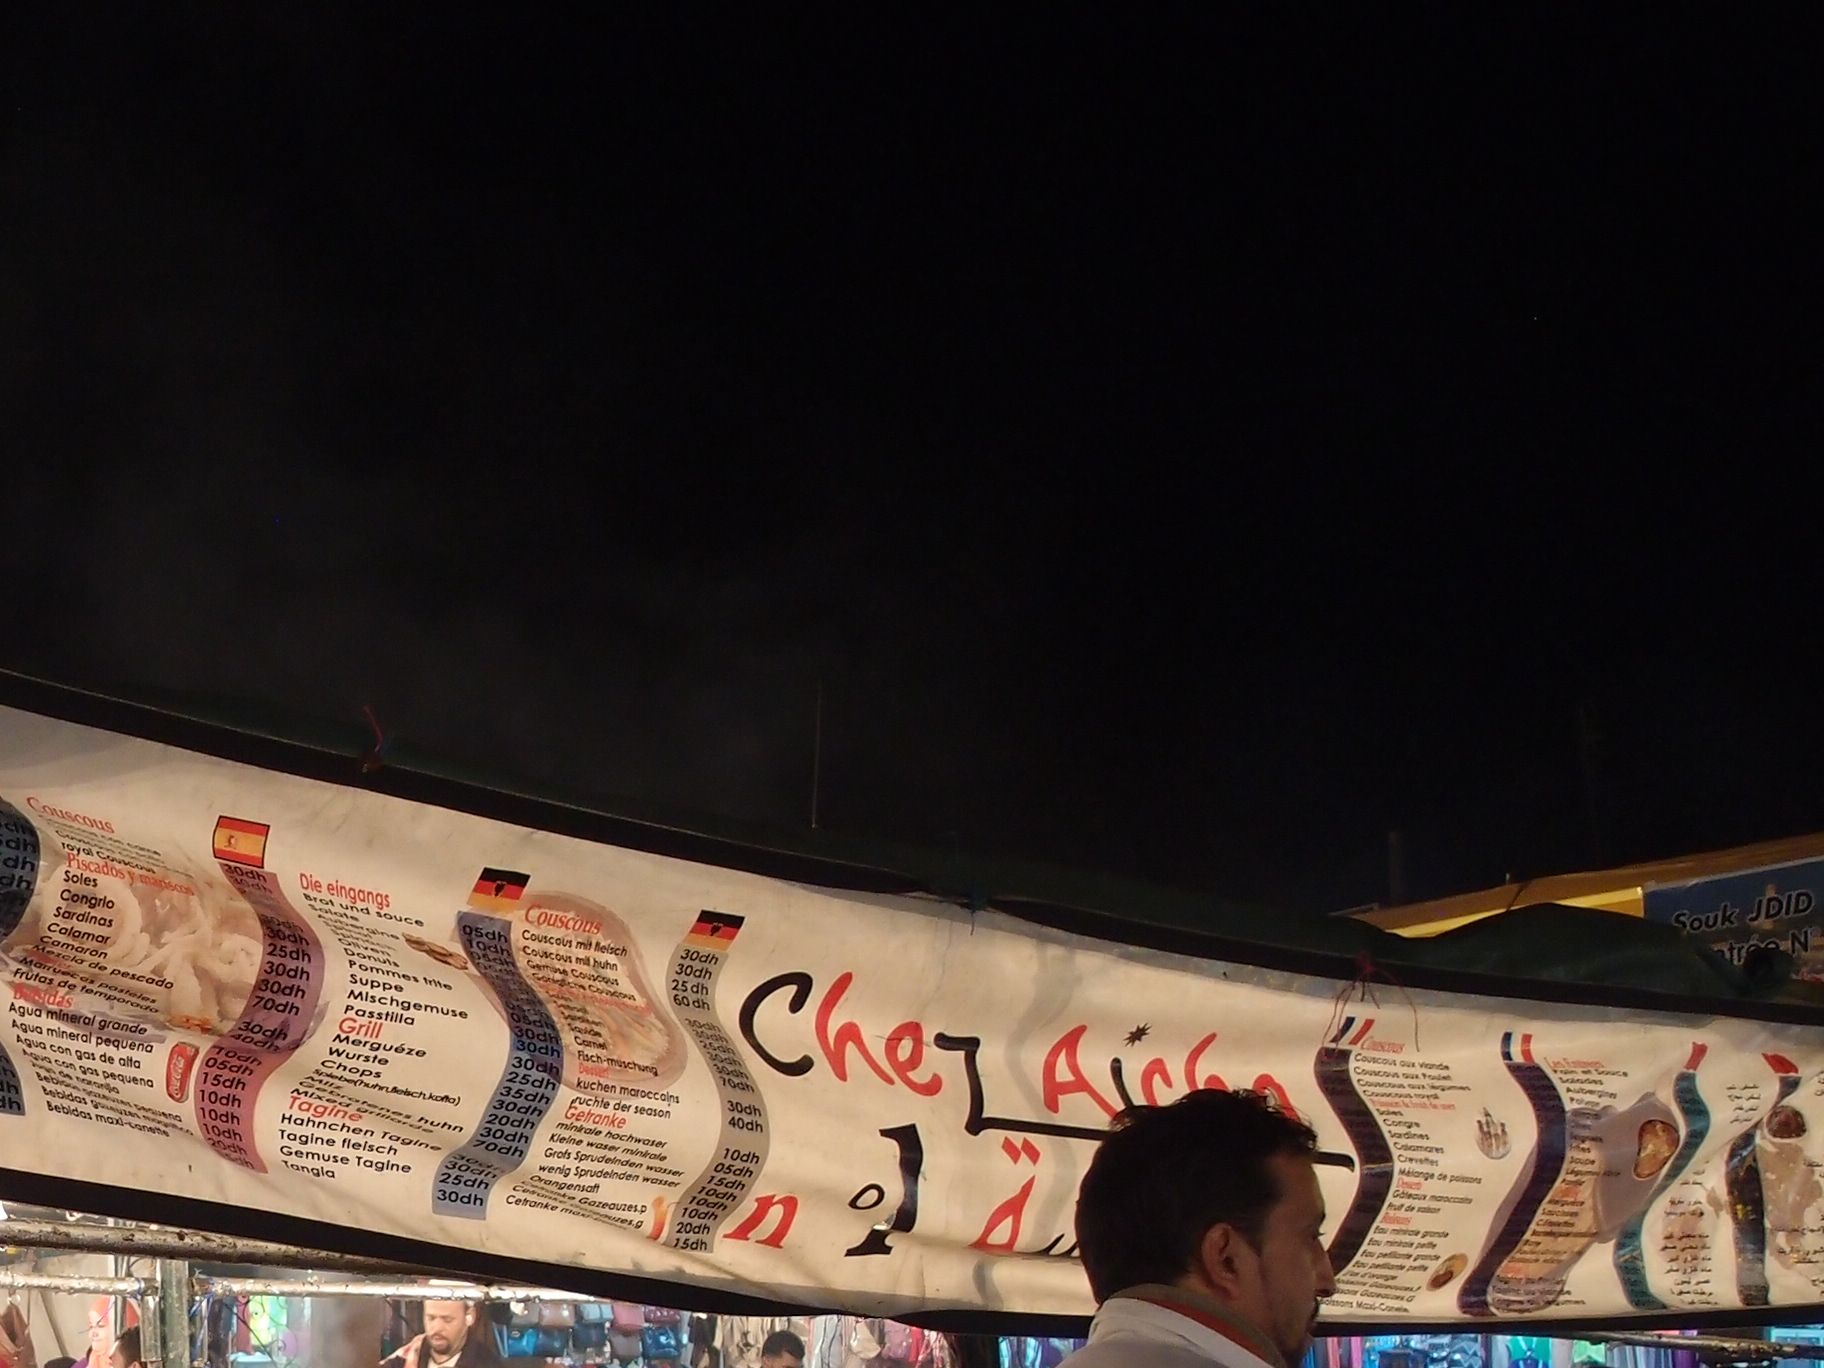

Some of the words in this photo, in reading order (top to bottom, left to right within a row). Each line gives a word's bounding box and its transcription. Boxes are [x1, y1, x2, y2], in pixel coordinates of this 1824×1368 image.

[26, 796, 115, 834] Couscous
[63, 869, 99, 888] Soles
[60, 889, 115, 910] Congrio
[300, 873, 323, 893] Die
[327, 879, 391, 910] eingangs
[53, 906, 114, 928] Sardinas
[340, 902, 370, 915] und
[376, 910, 425, 927] souce
[1747, 889, 1815, 924] JDID
[525, 904, 602, 935] Couscous
[47, 922, 111, 945] Calamar
[521, 929, 573, 948] Couscous
[680, 949, 719, 966] 30dh
[13, 968, 54, 987] Frutas
[58, 979, 77, 991] de
[263, 961, 311, 982] 30dh
[349, 973, 404, 993] Suppe
[251, 995, 301, 1016] 70dh
[344, 1004, 415, 1026] Passtilla
[9, 1001, 42, 1018] Agua
[46, 1009, 95, 1027] mineral
[99, 1017, 148, 1036] grande
[339, 1017, 383, 1039] Grill
[328, 1046, 390, 1066] Wurste
[332, 1033, 427, 1058] Merguéze
[738, 971, 984, 1137] Chez
[320, 1059, 383, 1079] Chops
[576, 1077, 617, 1095] kuchen
[199, 1089, 242, 1108] 10dh
[289, 1095, 363, 1122] Tagine
[727, 1100, 762, 1117] 30dh
[634, 1104, 671, 1119] season
[280, 1113, 375, 1138] Hahnchen
[278, 1129, 337, 1149] Tagine
[341, 1135, 398, 1156] fleisch
[279, 1144, 350, 1165] Gemuse
[355, 1156, 412, 1174] Tagine
[723, 1148, 760, 1165] 10dh
[437, 1172, 490, 1191] 25dh
